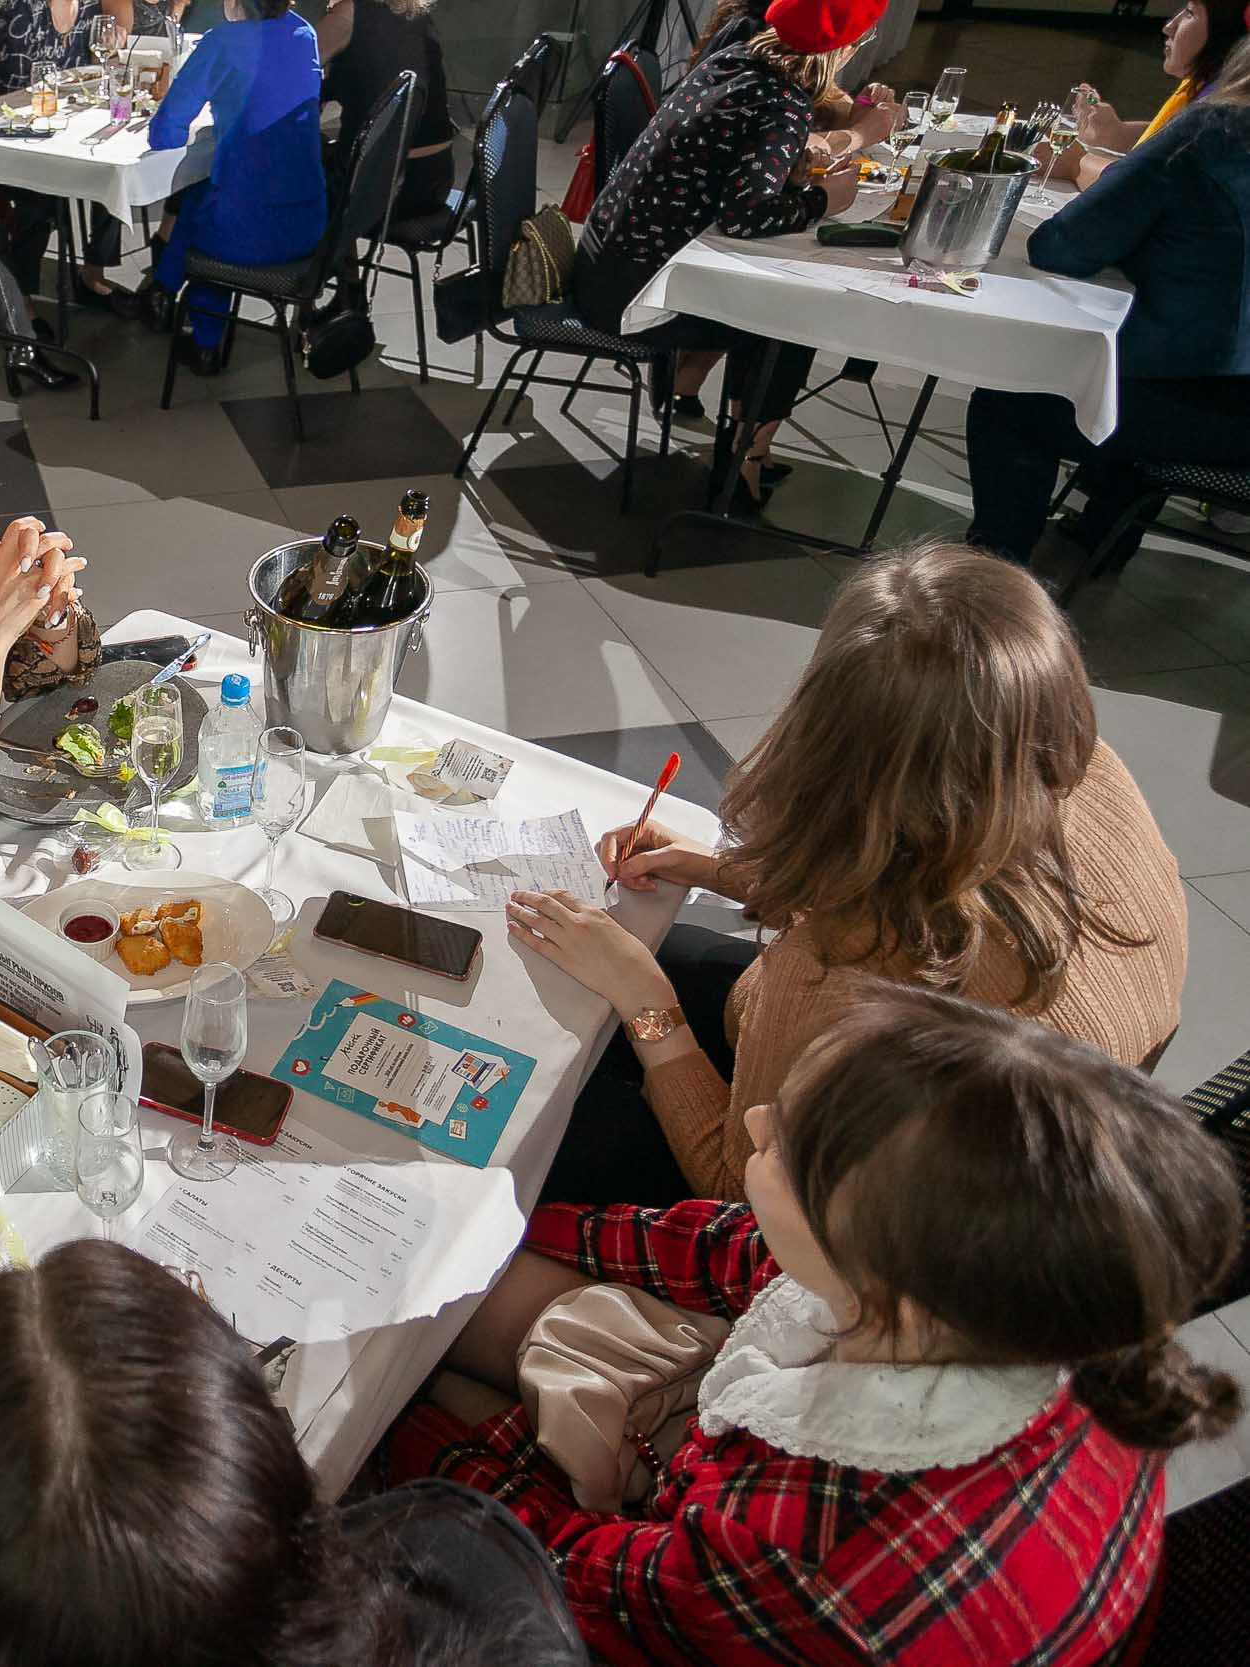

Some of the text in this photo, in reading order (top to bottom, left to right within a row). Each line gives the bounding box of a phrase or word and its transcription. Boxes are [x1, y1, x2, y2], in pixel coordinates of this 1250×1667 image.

[347, 1027, 382, 1076] ПОДАРОЧНЫЙ
[358, 1034, 388, 1076] СЕРТИФИКАТ
[182, 1188, 209, 1207] САЛАТЫ
[346, 1167, 378, 1186] ГОРЯЧИЕ
[376, 1182, 407, 1204] ЗАКУСКИ
[269, 1264, 302, 1287] ДЕСЕРТЫ
